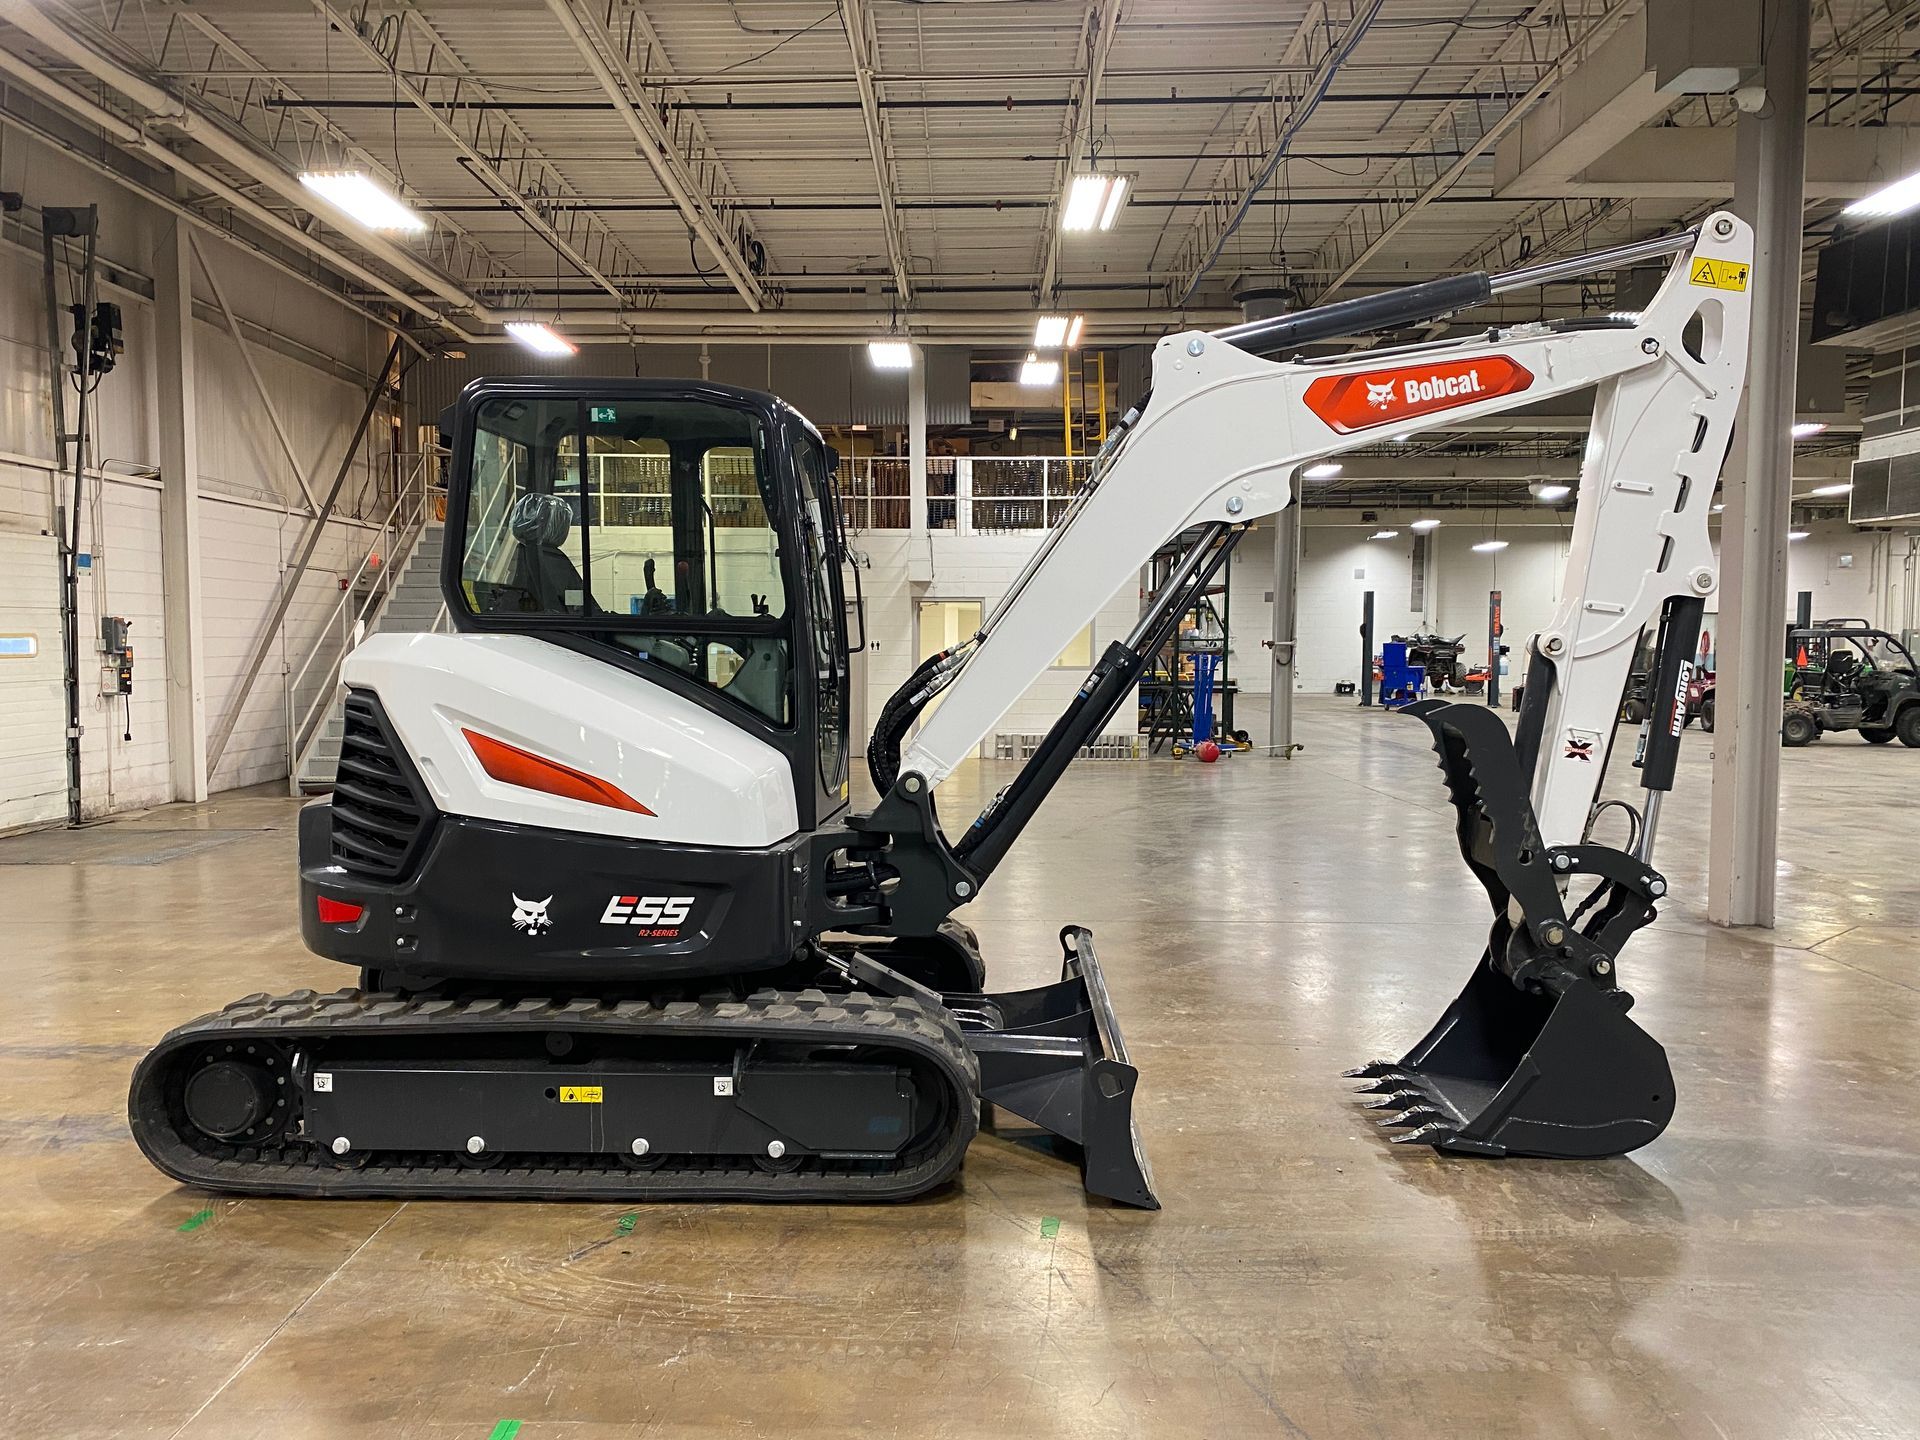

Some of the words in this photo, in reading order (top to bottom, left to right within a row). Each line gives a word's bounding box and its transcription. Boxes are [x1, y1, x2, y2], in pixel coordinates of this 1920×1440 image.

[1404, 370, 1480, 404] Bobcat
[1671, 659, 1694, 738] LongArm
[599, 895, 695, 925] E55
[638, 929, 679, 938] R2-SERIES
